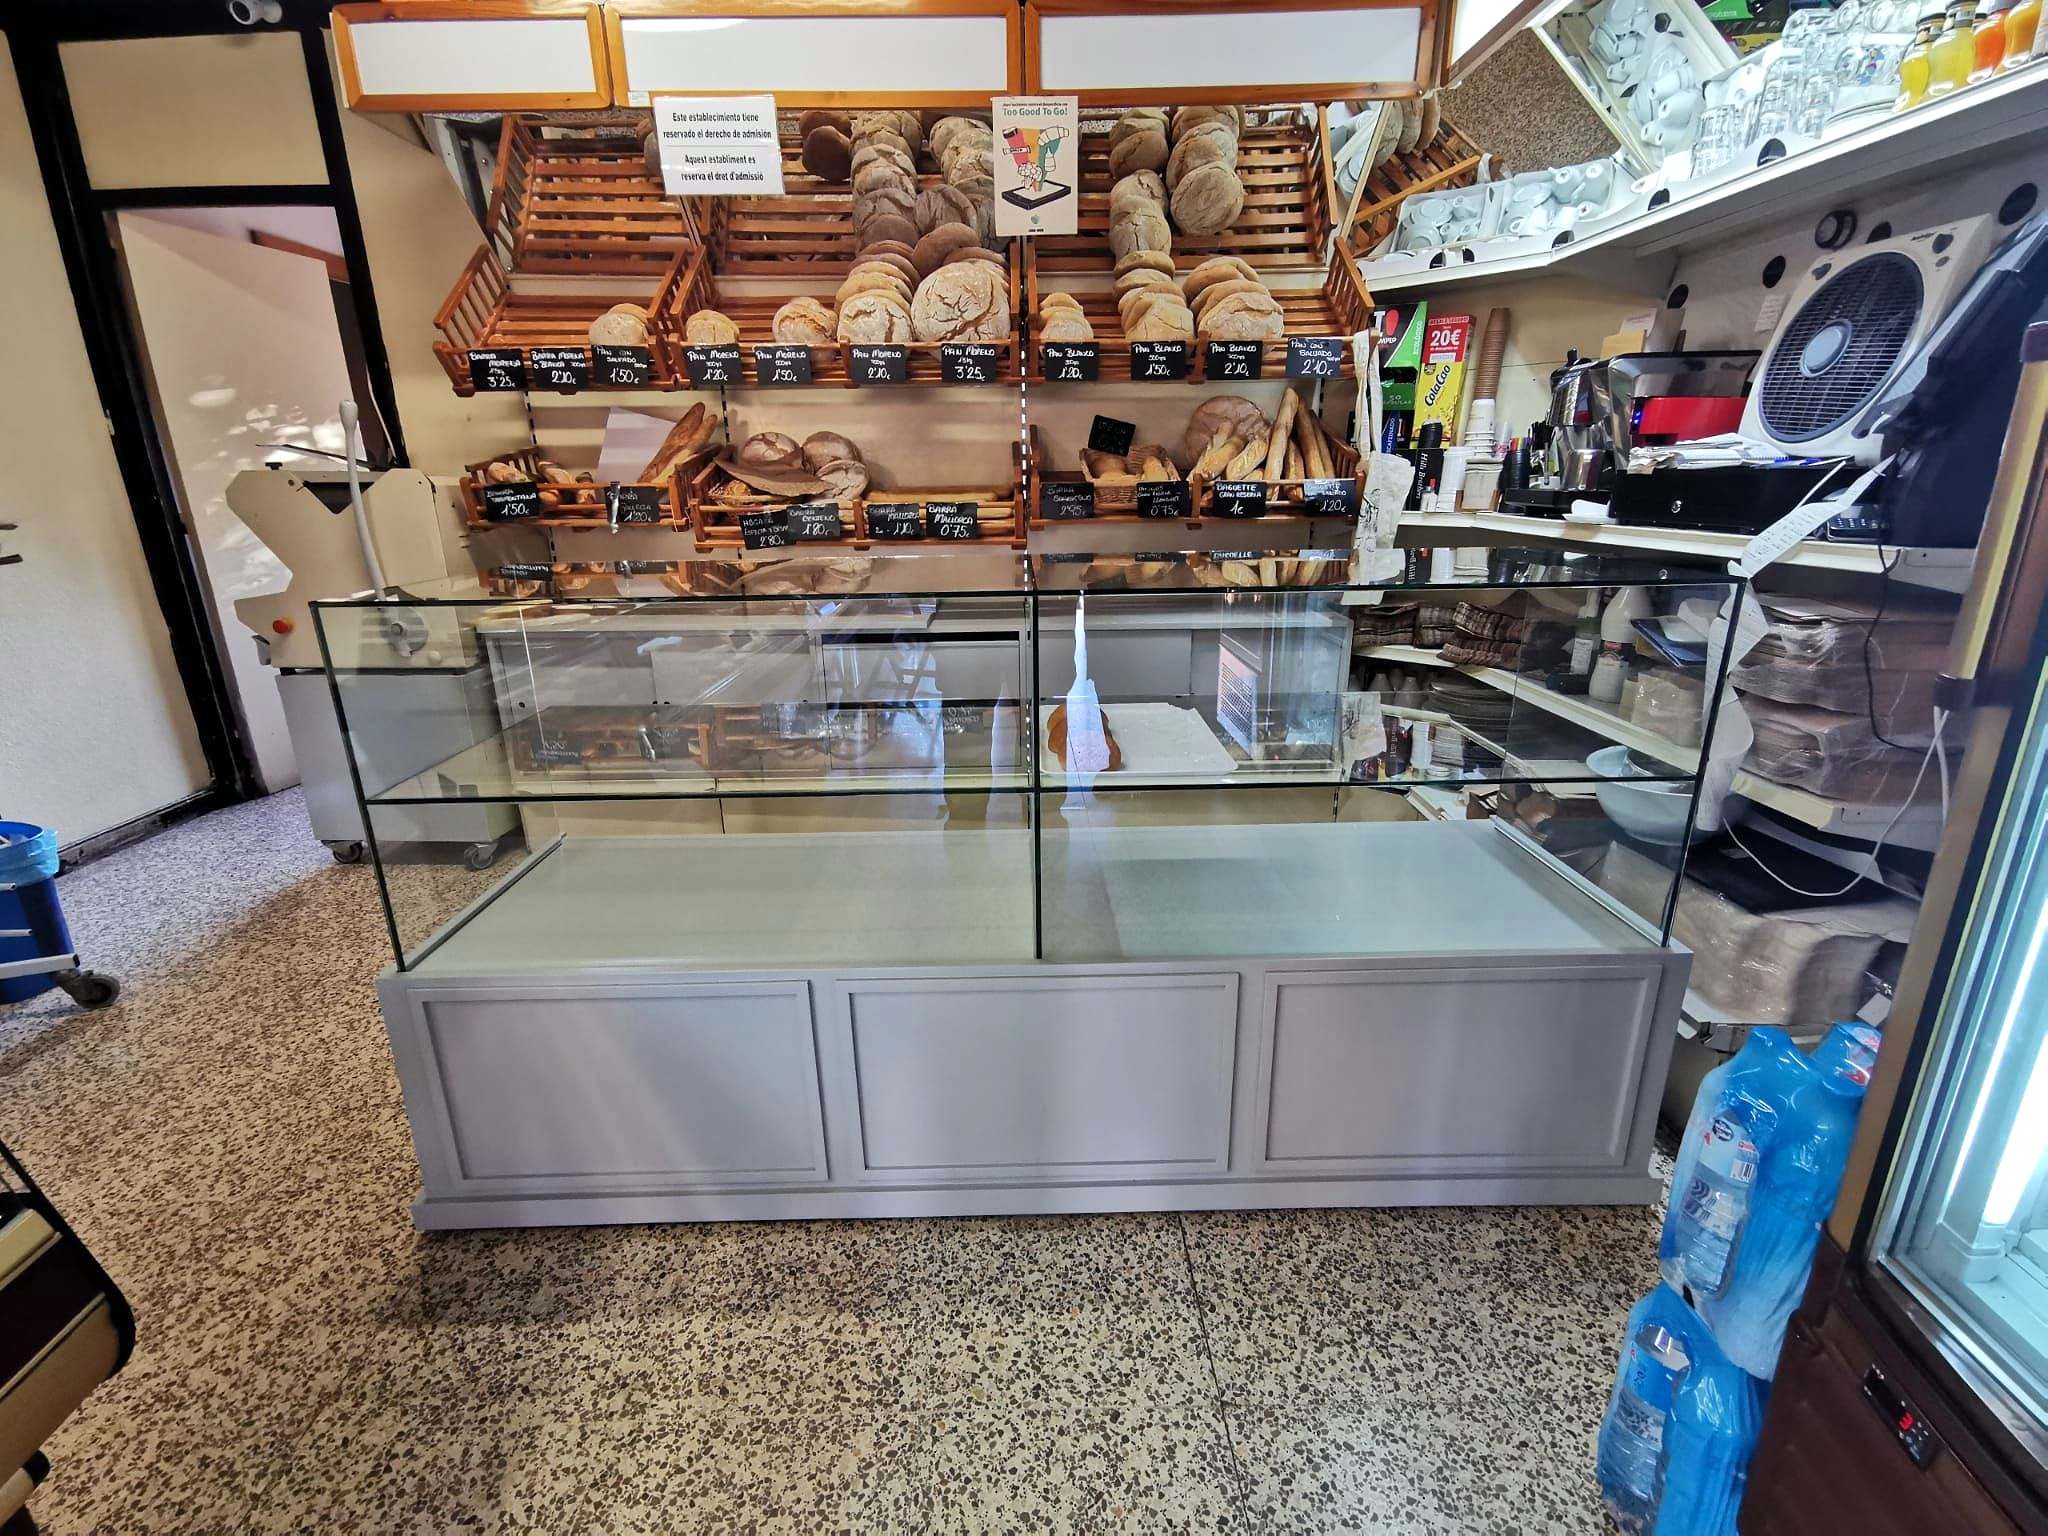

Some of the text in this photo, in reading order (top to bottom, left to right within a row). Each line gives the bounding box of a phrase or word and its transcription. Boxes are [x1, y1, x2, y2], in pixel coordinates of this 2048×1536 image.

[672, 112, 759, 122] Este establecimiento tiene
[1003, 107, 1068, 116] Too Good To Go!
[663, 129, 696, 138] reservado
[697, 129, 704, 138] el
[705, 129, 732, 138] derecho
[732, 129, 741, 138] de
[685, 154, 756, 165] Aquest establiment es
[681, 172, 706, 181] reserva
[707, 171, 714, 181] el
[715, 171, 729, 181] dret
[1289, 337, 1307, 349] PAN
[1430, 329, 1462, 347] 20€
[852, 348, 902, 358] PAN MORENO
[942, 345, 996, 356] PAN MORENO
[1046, 347, 1095, 358] PAN BLANCO
[1132, 342, 1182, 354] PAN BLANCO
[1210, 342, 1257, 354] PAN BLANCO
[687, 350, 740, 361] PAN MORENO
[756, 350, 807, 360] PAN MORENO
[1424, 364, 1452, 407] ColaCao
[927, 503, 957, 513] BARRA
